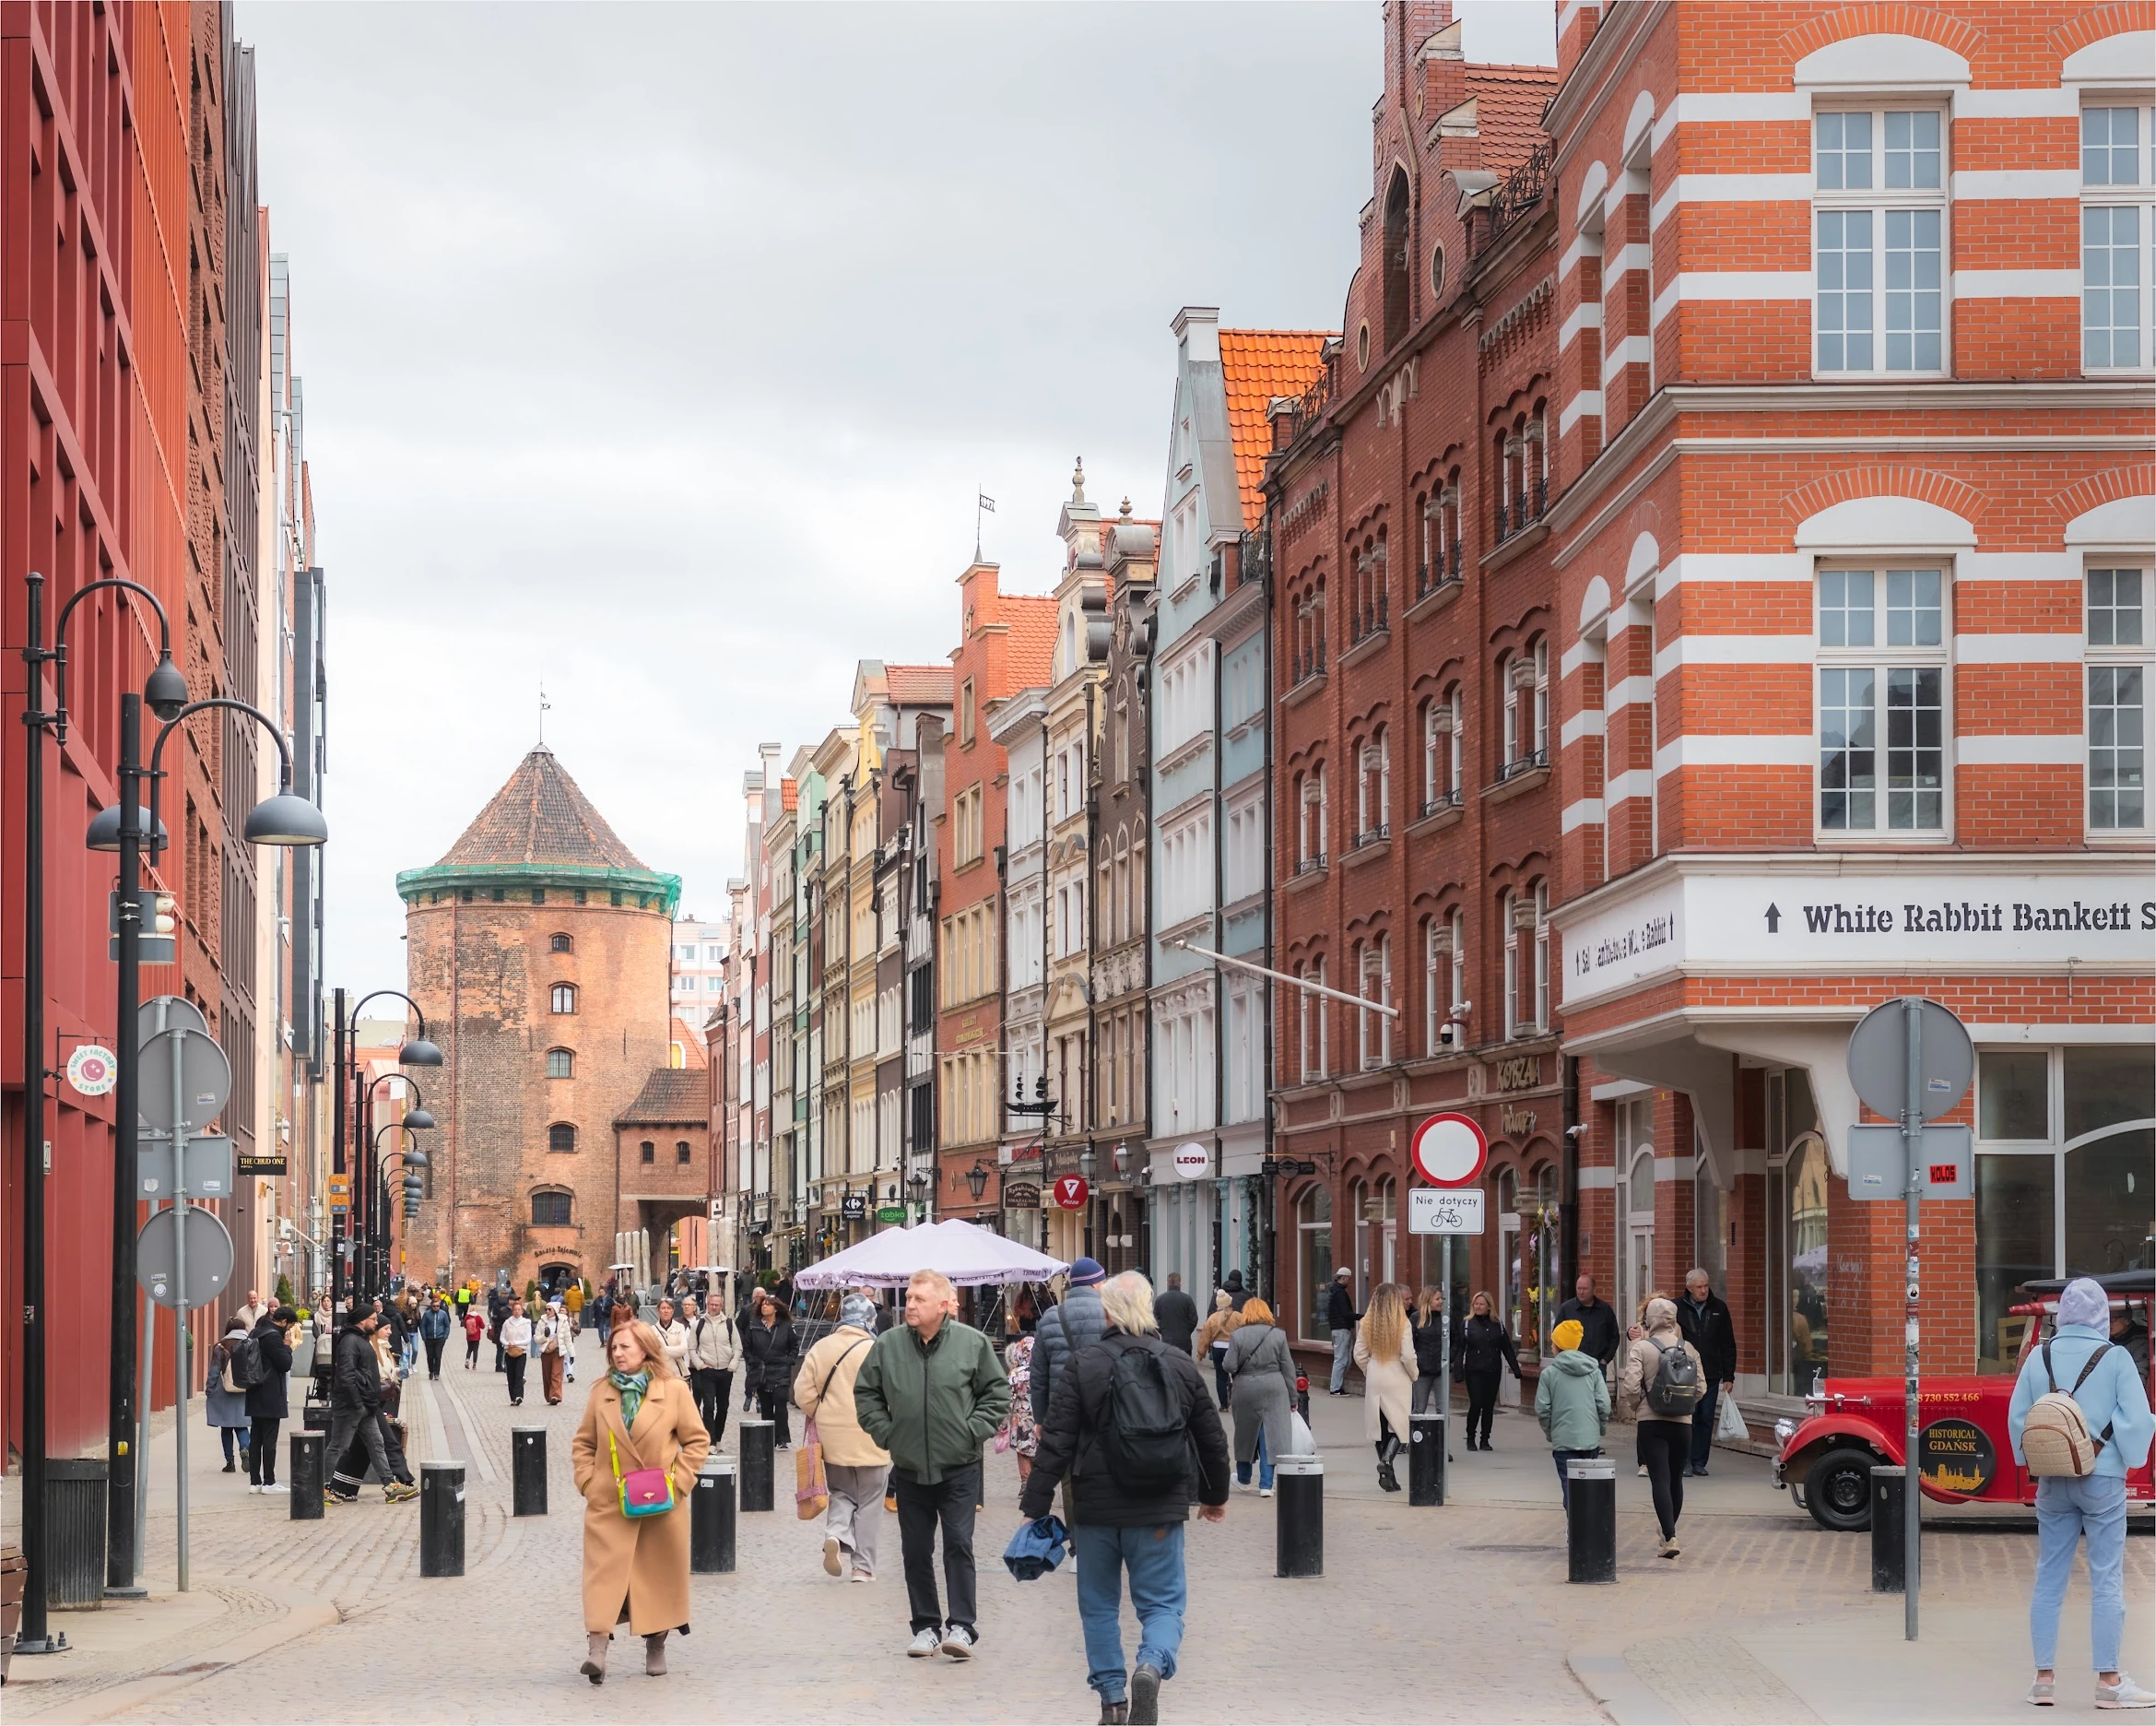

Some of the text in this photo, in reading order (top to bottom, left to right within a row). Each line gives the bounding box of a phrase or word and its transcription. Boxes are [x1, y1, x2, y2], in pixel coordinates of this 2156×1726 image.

[1803, 904, 1892, 933] White
[1903, 903, 2002, 932] Rabbit
[2013, 902, 2131, 931] Bankett
[1646, 917, 1667, 950] Rabbit
[70, 1049, 116, 1069] SWEET FACTORY
[74, 1083, 106, 1093] STORE
[1416, 1196, 1478, 1208] Nie dotyczy
[1925, 1393, 1941, 1402] 730
[1943, 1393, 1960, 1402] 552
[1962, 1392, 1979, 1401] 466
[1929, 1428, 1976, 1439] HISTORICAL
[1929, 1439, 1976, 1451] GDAŃSK
